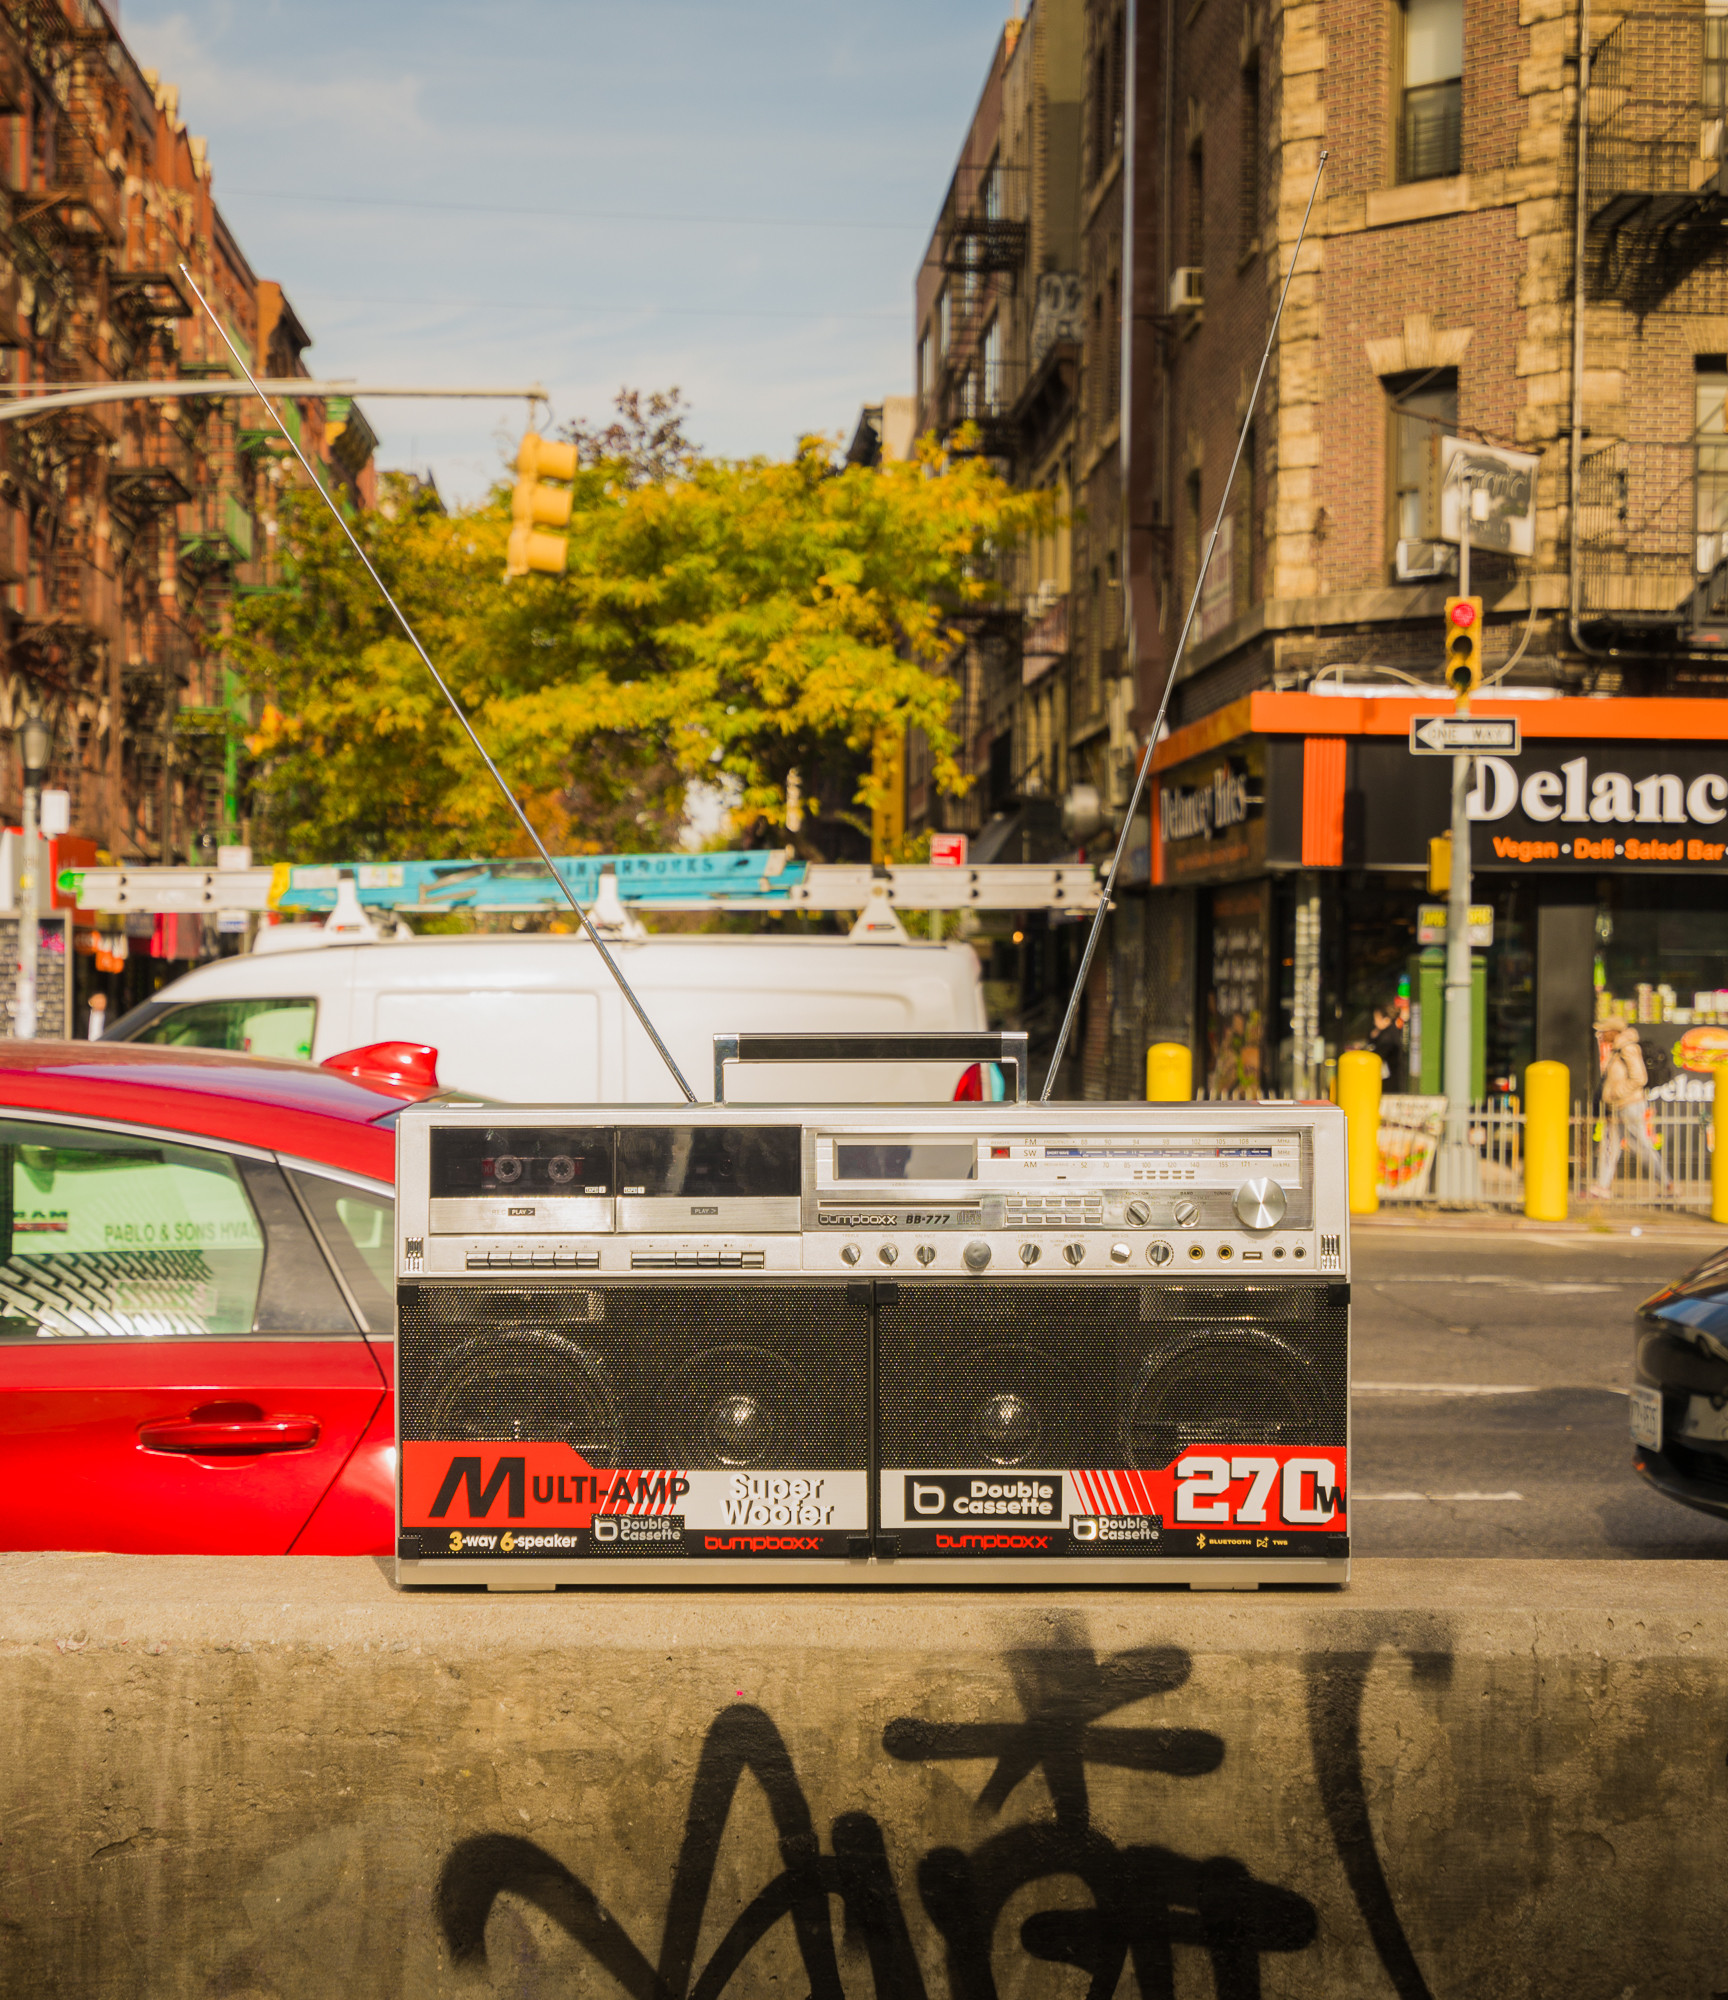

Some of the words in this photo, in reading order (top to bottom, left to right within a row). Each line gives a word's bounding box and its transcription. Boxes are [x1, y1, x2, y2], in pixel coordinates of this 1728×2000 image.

[1428, 727, 1457, 740] ONE
[1472, 726, 1503, 740] WAY
[1493, 836, 1559, 863] Vegan
[1574, 838, 1616, 860] Deli
[1624, 838, 1684, 860] Salad
[1687, 838, 1725, 861] Bar
[1023, 1149, 1037, 1157] SW
[818, 1213, 897, 1228] bumpboxx
[104, 1224, 156, 1242] PABLO
[161, 1224, 169, 1241] &
[174, 1223, 215, 1241] SONS
[428, 1457, 690, 1519] MULTI-AMP
[729, 1473, 825, 1504] Super
[970, 1480, 1053, 1498] Double
[719, 1499, 835, 1526] Woofer
[953, 1497, 1053, 1515] Cassette
[620, 1518, 670, 1530] Double
[1098, 1517, 1149, 1529] Double
[449, 1530, 498, 1551] 3-way
[500, 1530, 578, 1551] 6-speaker
[620, 1529, 681, 1541] Cassette
[935, 1533, 1049, 1550] bumpboxx
[1098, 1528, 1160, 1540] Cassette
[704, 1535, 820, 1552] bumpboxx
